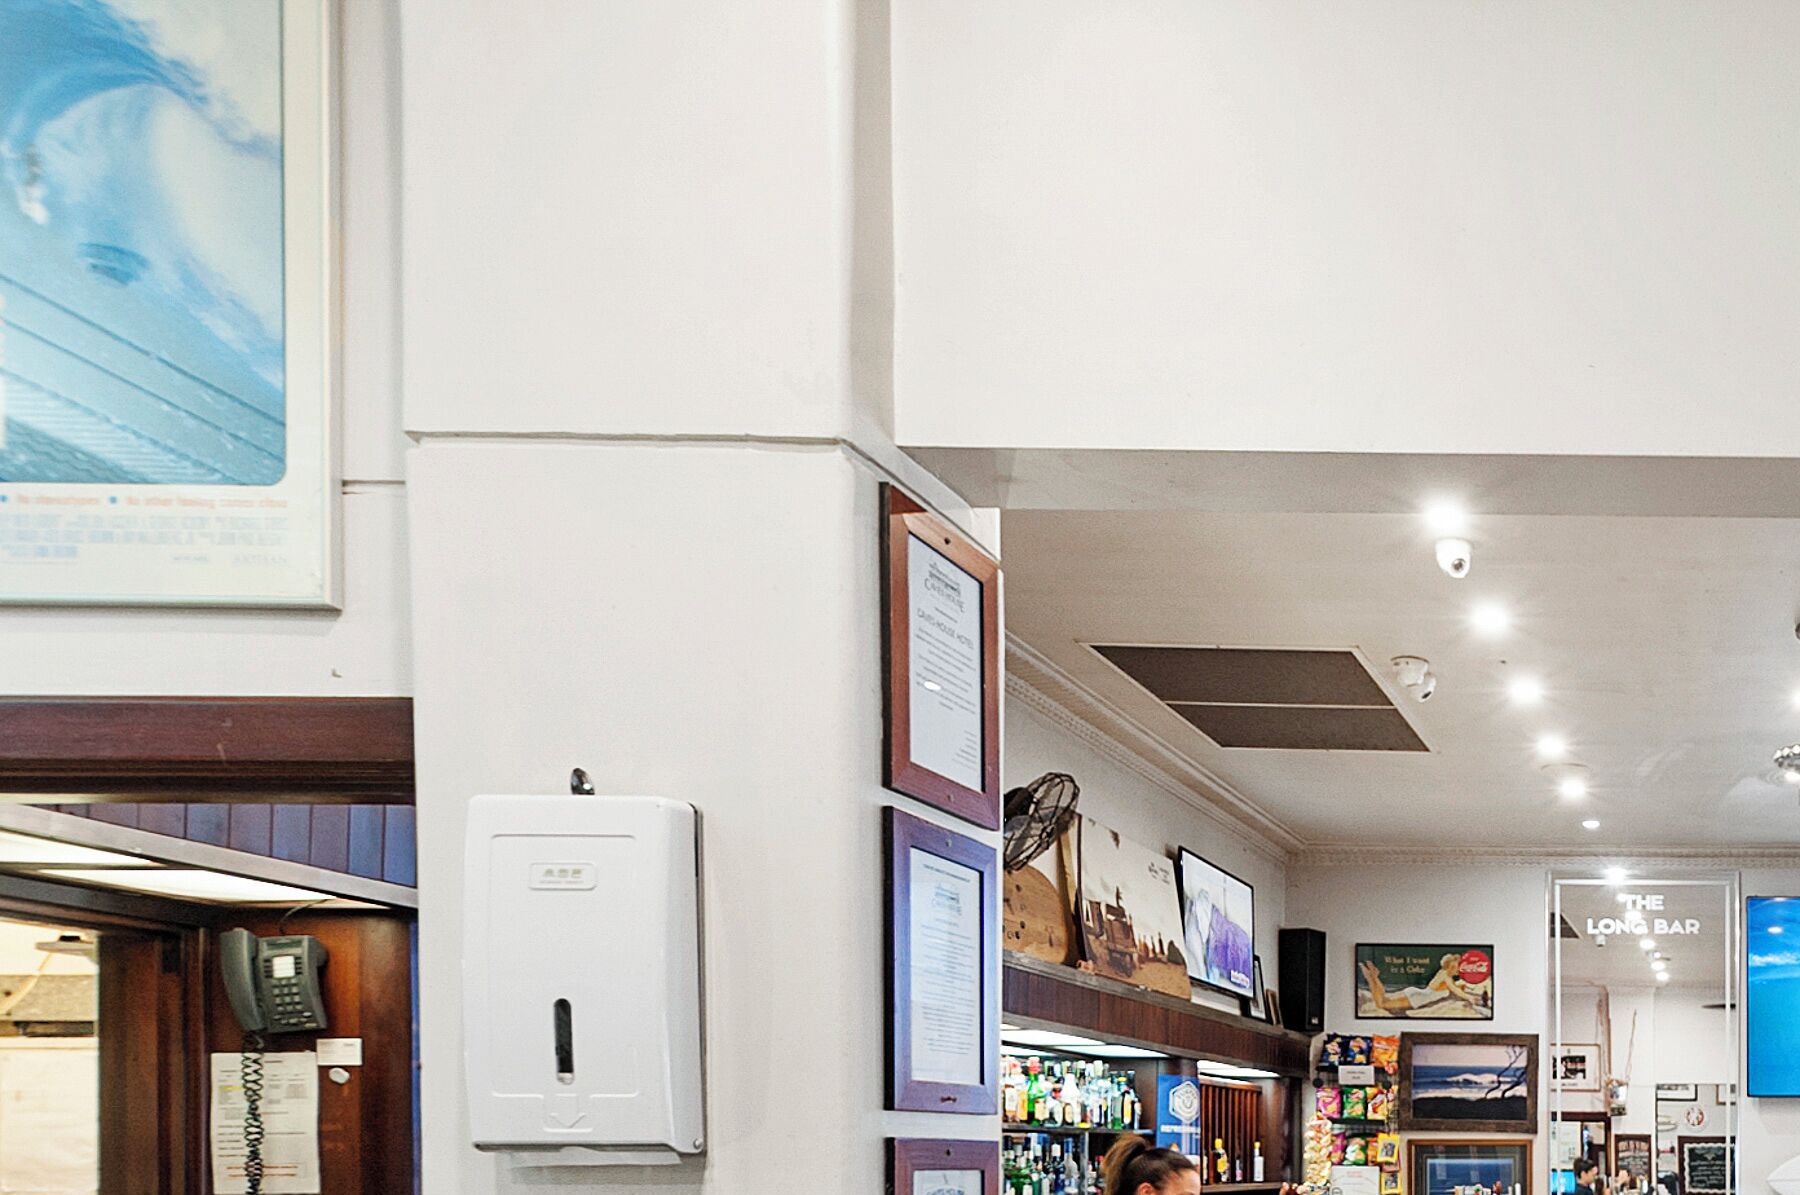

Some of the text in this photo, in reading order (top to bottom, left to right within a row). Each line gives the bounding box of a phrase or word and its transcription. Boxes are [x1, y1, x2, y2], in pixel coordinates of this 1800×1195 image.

[1624, 894, 1665, 910] THE
[1587, 917, 1701, 935] LONG BAR
